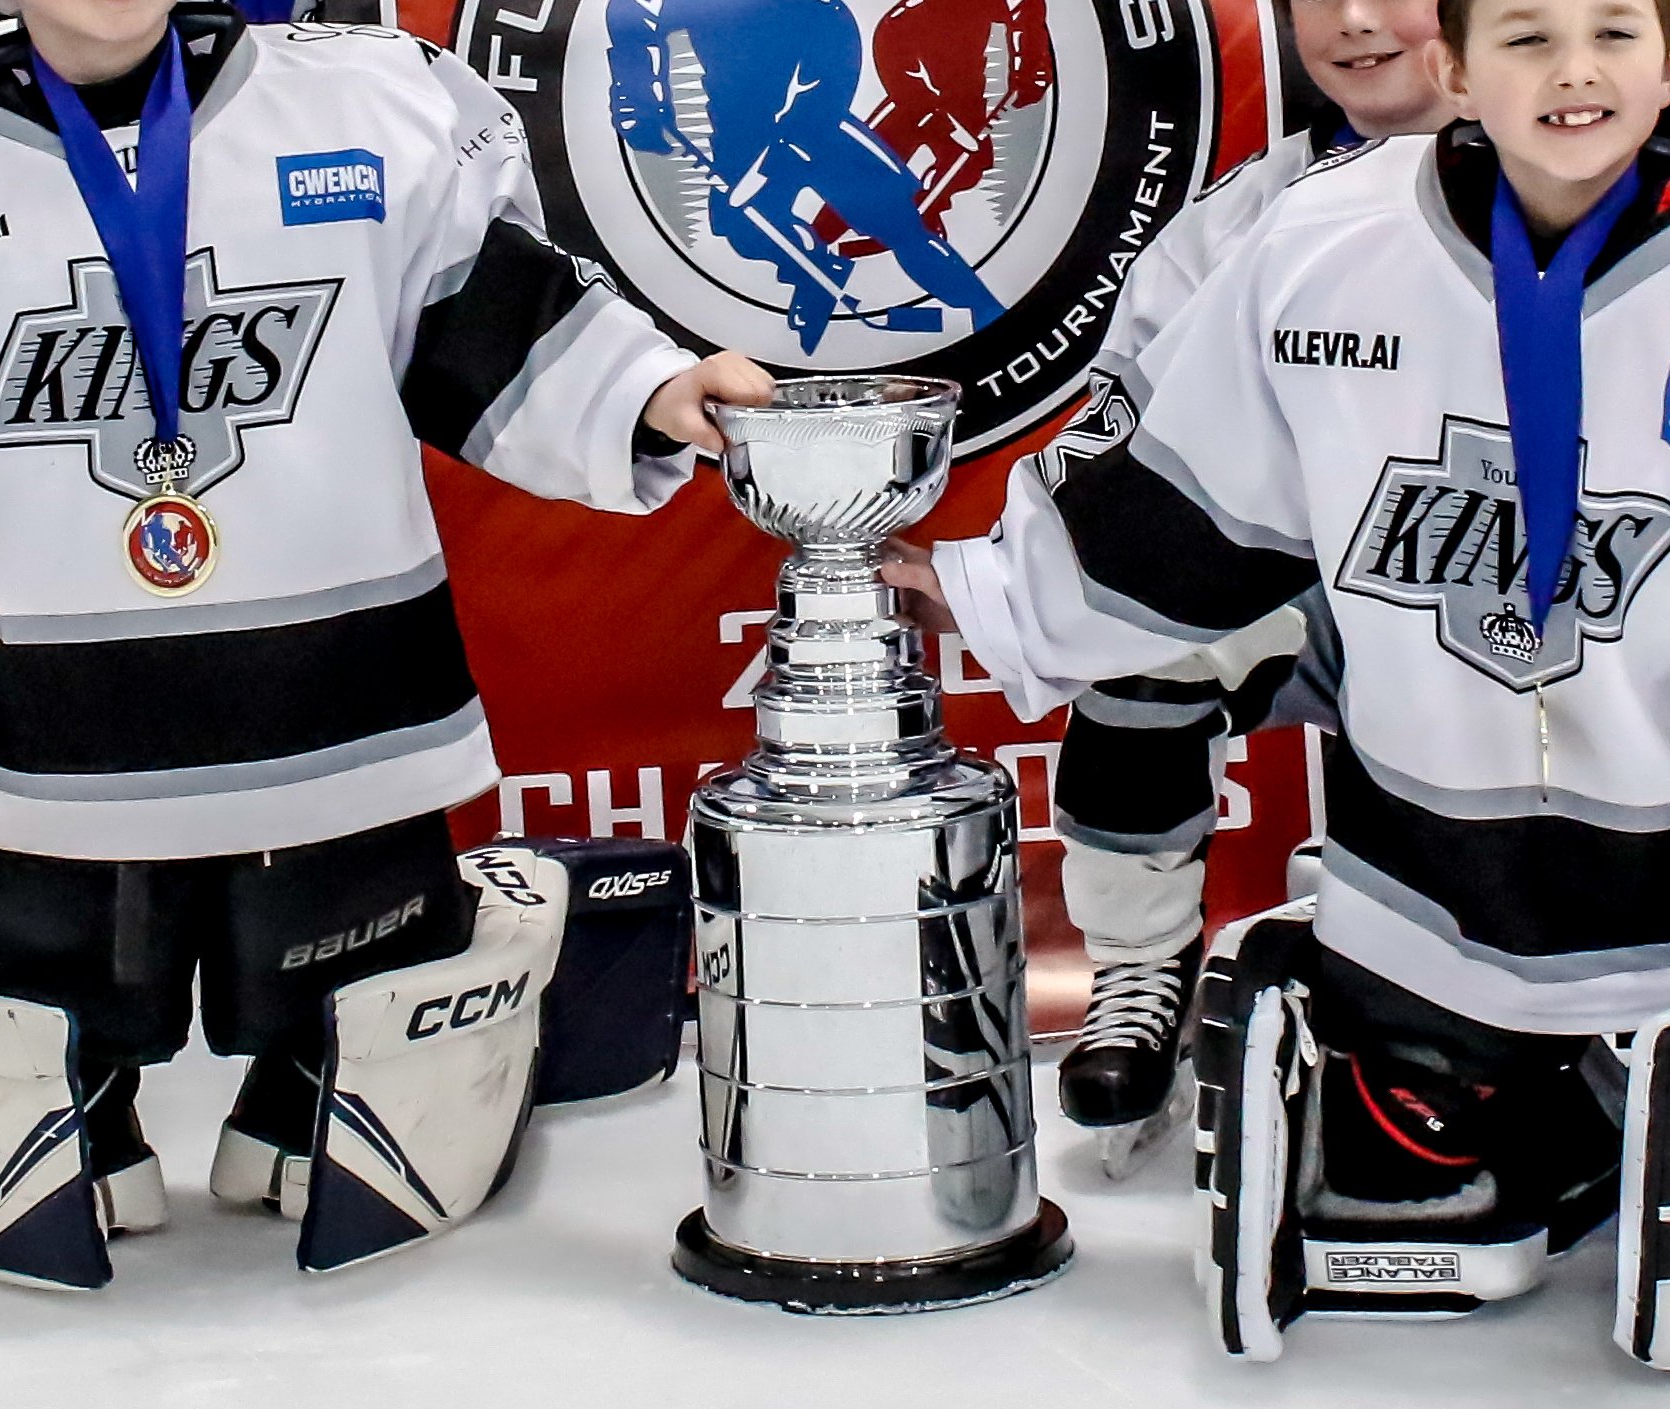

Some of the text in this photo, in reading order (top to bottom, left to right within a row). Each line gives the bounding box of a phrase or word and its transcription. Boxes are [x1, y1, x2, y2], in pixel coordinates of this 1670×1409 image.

[288, 164, 380, 198] CWENCH
[290, 193, 383, 208] HYDRATION
[976, 111, 1179, 398] TOURNAMENT
[1273, 328, 1400, 372] KLEVR.AI
[1480, 458, 1519, 487] You
[463, 849, 548, 908] CCM
[406, 970, 531, 1042] CCM
[1332, 1267, 1457, 1279] BALANCE
